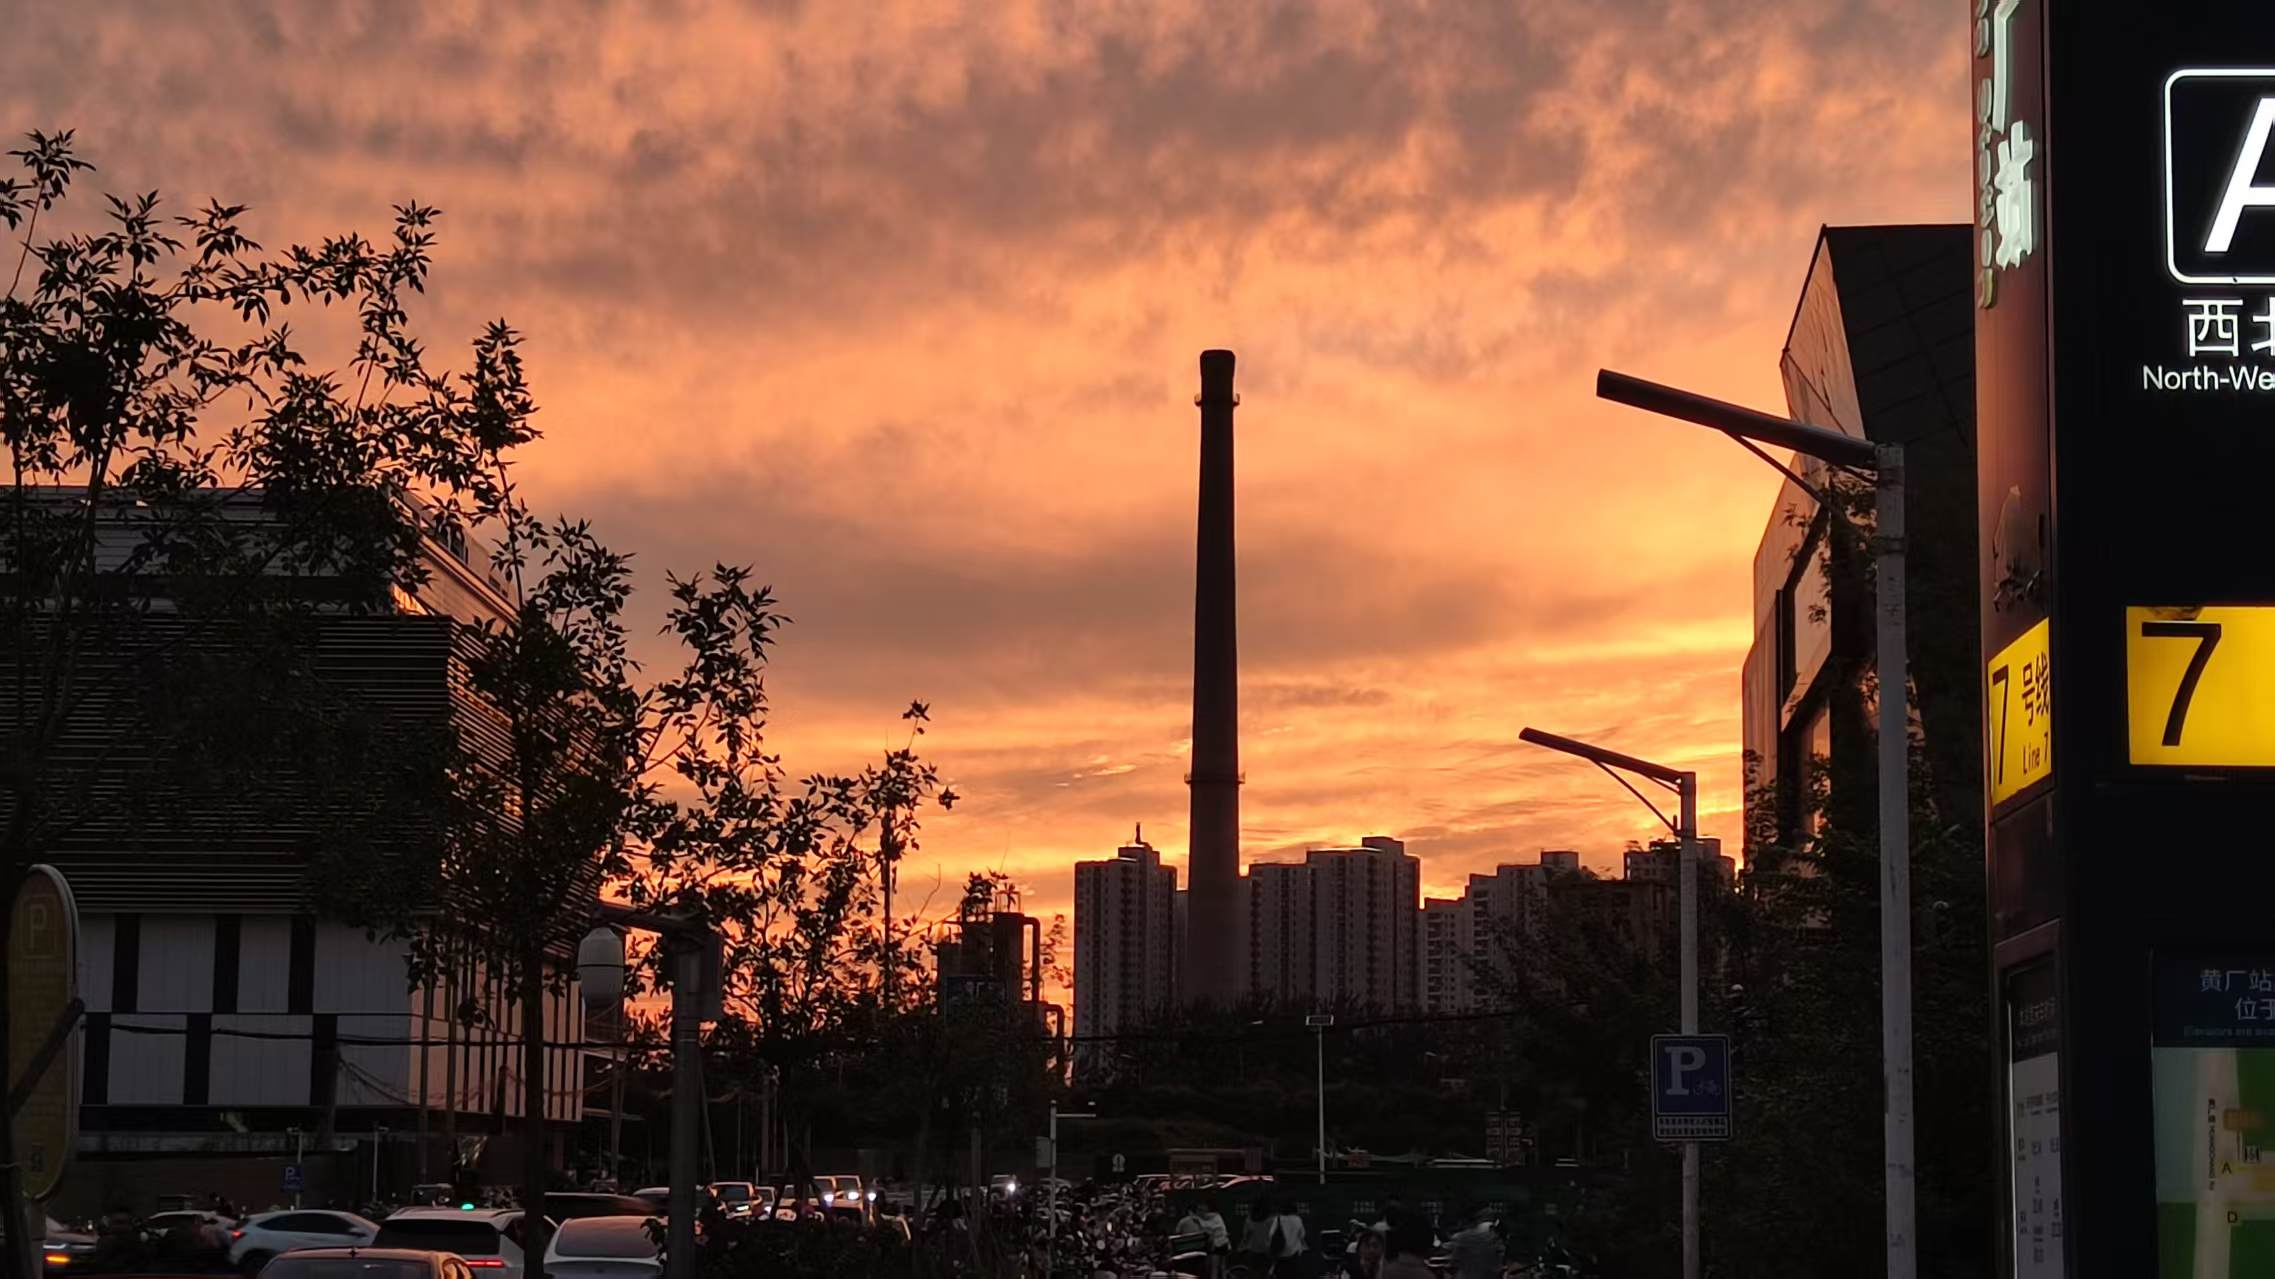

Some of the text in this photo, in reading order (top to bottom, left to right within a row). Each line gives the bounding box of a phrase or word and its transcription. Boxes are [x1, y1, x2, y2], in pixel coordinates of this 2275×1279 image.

[2143, 364, 2275, 391] North-We
[2141, 621, 2222, 747] 7
[1992, 651, 2050, 785] 7 号线
[2022, 731, 2050, 776] Line 7
[29, 903, 47, 951] P
[1664, 1046, 1706, 1095] P
[284, 1166, 296, 1181] P
[2221, 1161, 2232, 1174] A
[2227, 1210, 2238, 1223] D
